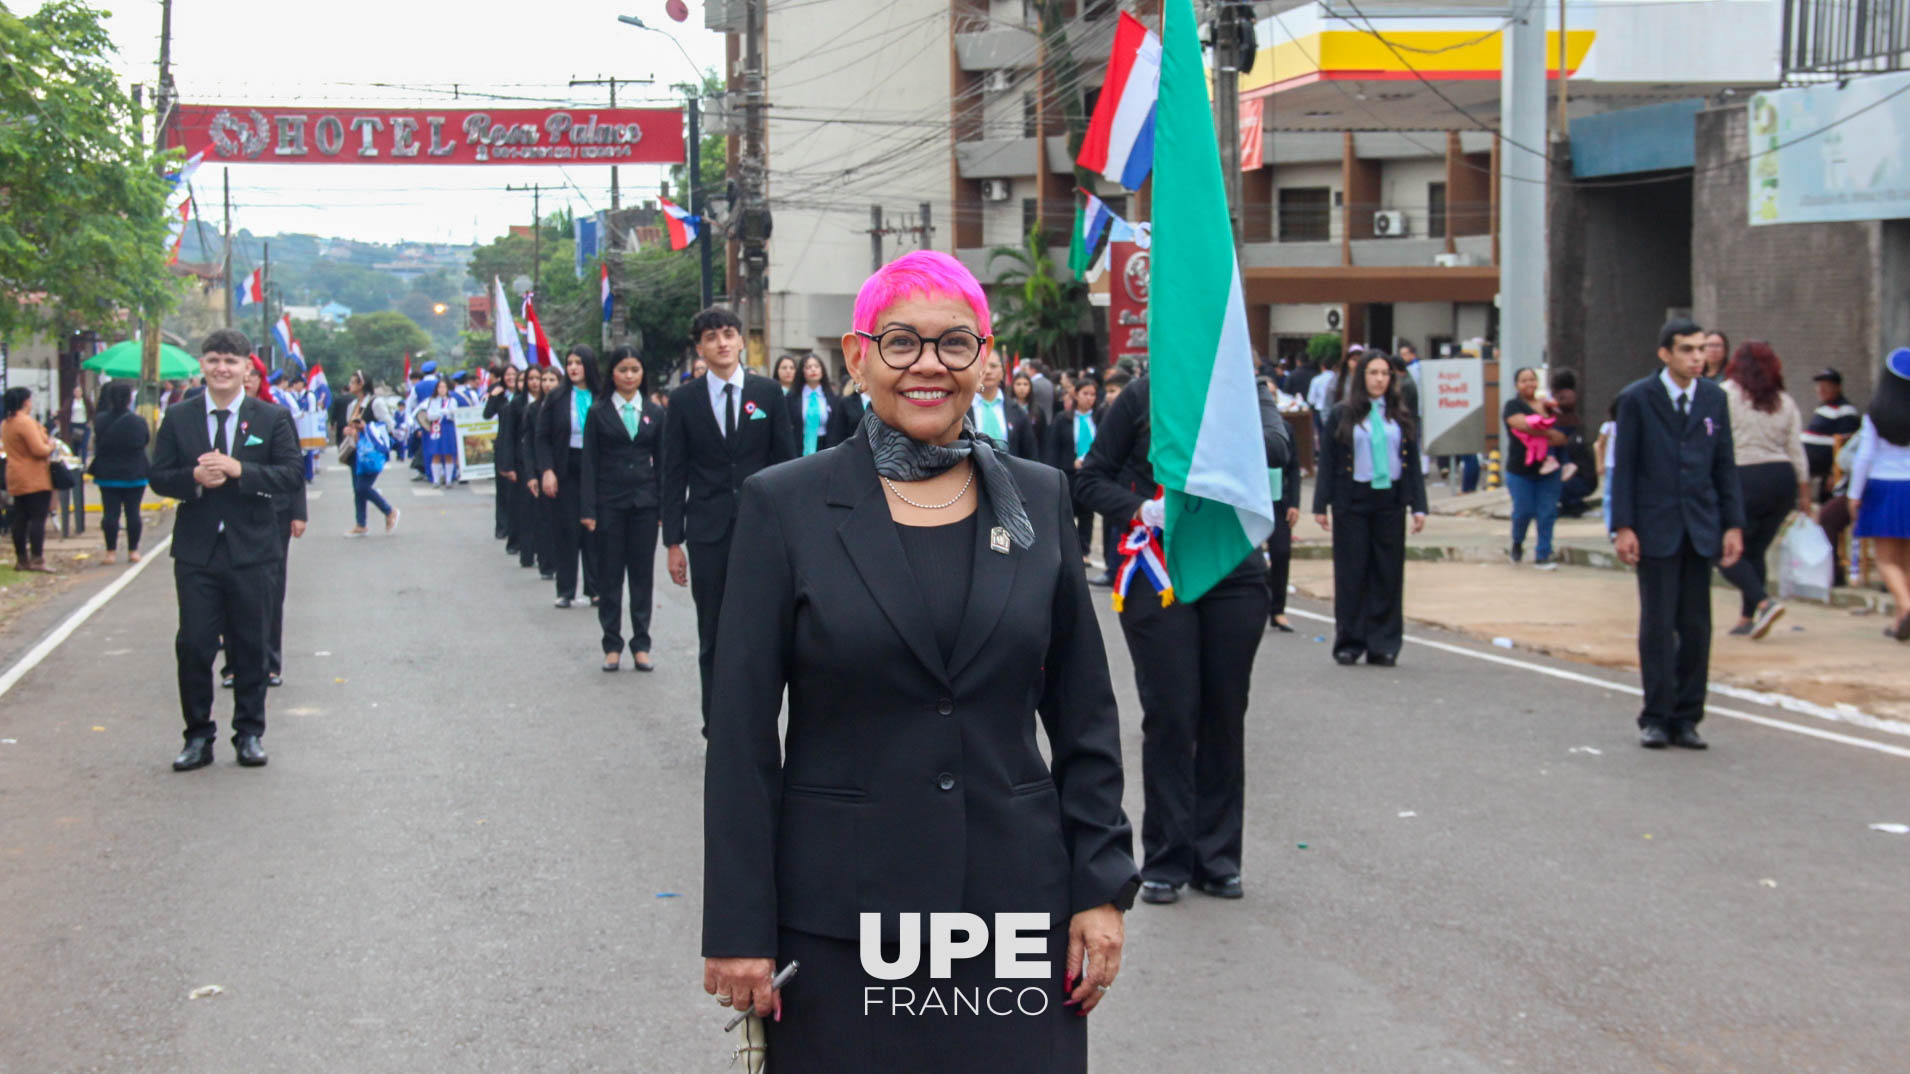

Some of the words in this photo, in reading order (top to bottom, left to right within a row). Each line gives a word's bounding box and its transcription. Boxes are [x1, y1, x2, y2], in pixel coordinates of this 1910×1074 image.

[274, 115, 456, 156] HOTEL
[462, 113, 540, 146] Rosa
[545, 112, 642, 145] Palace
[1438, 383, 1468, 393] Shell
